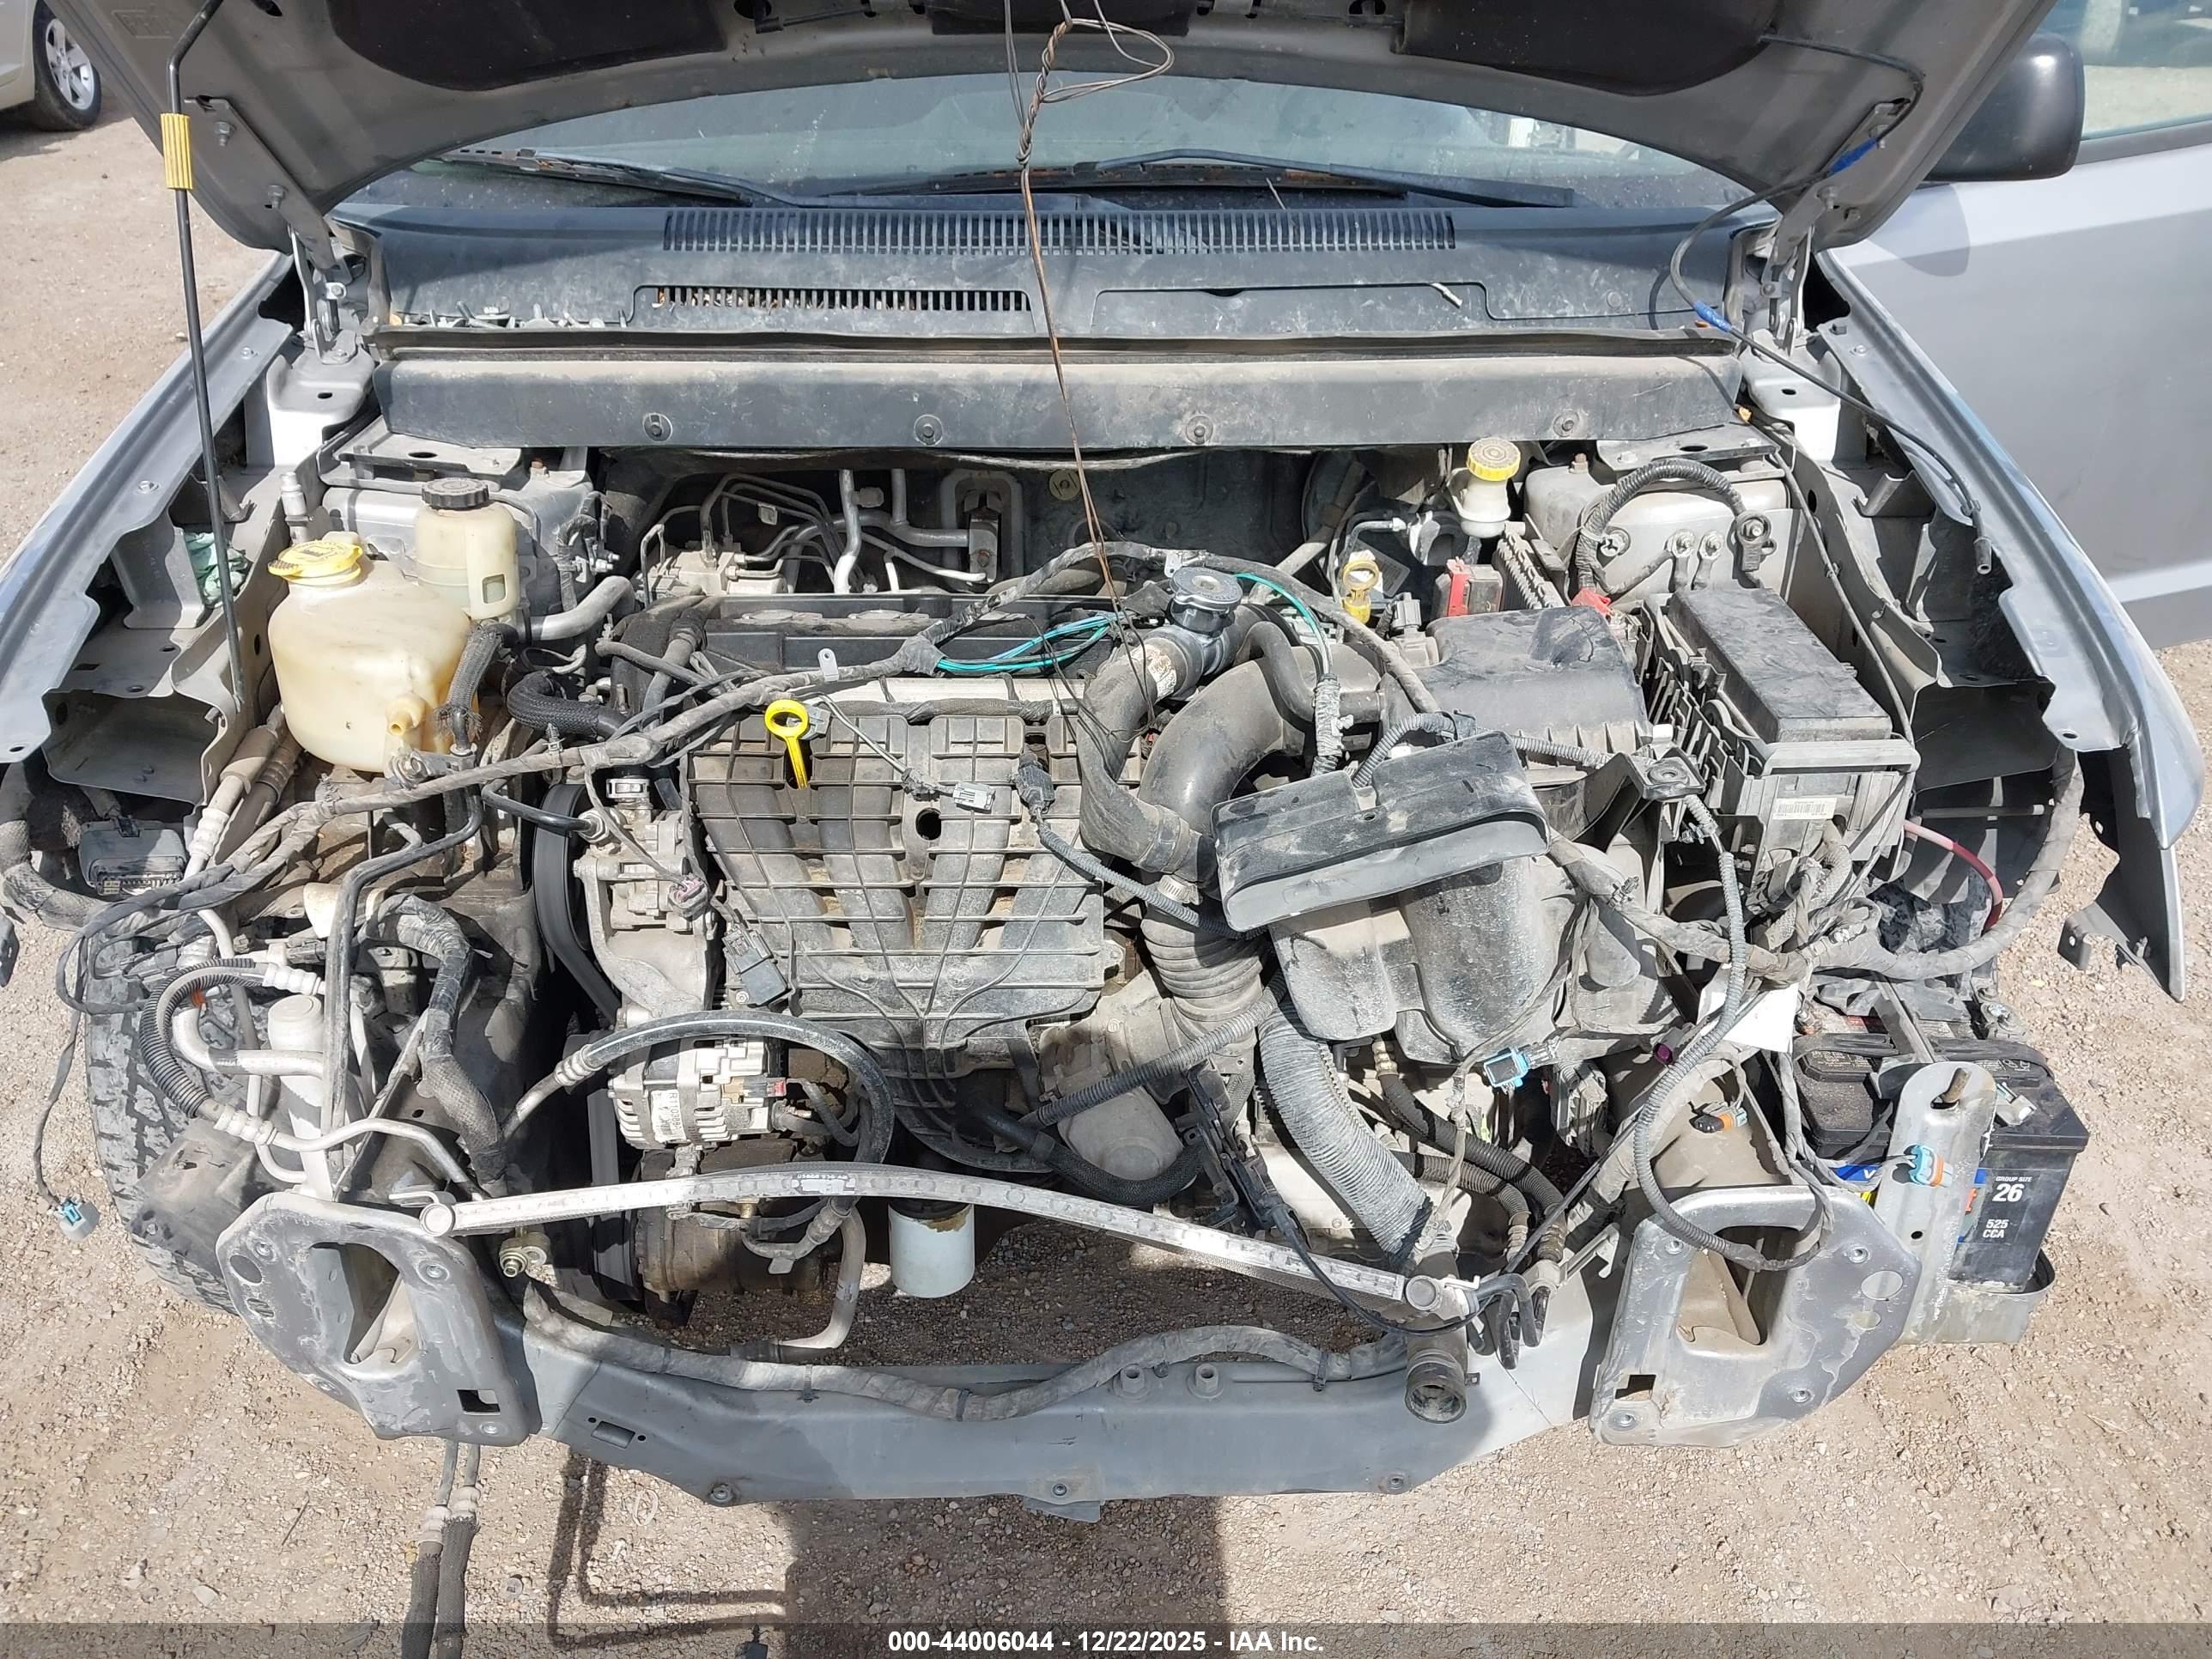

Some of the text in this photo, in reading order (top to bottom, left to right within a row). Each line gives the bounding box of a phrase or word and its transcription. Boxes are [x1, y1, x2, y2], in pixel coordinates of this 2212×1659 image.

[1992, 1183, 2024, 1202] 26
[1986, 1219, 2009, 1229] 525
[1983, 1230, 2005, 1238] CCA
